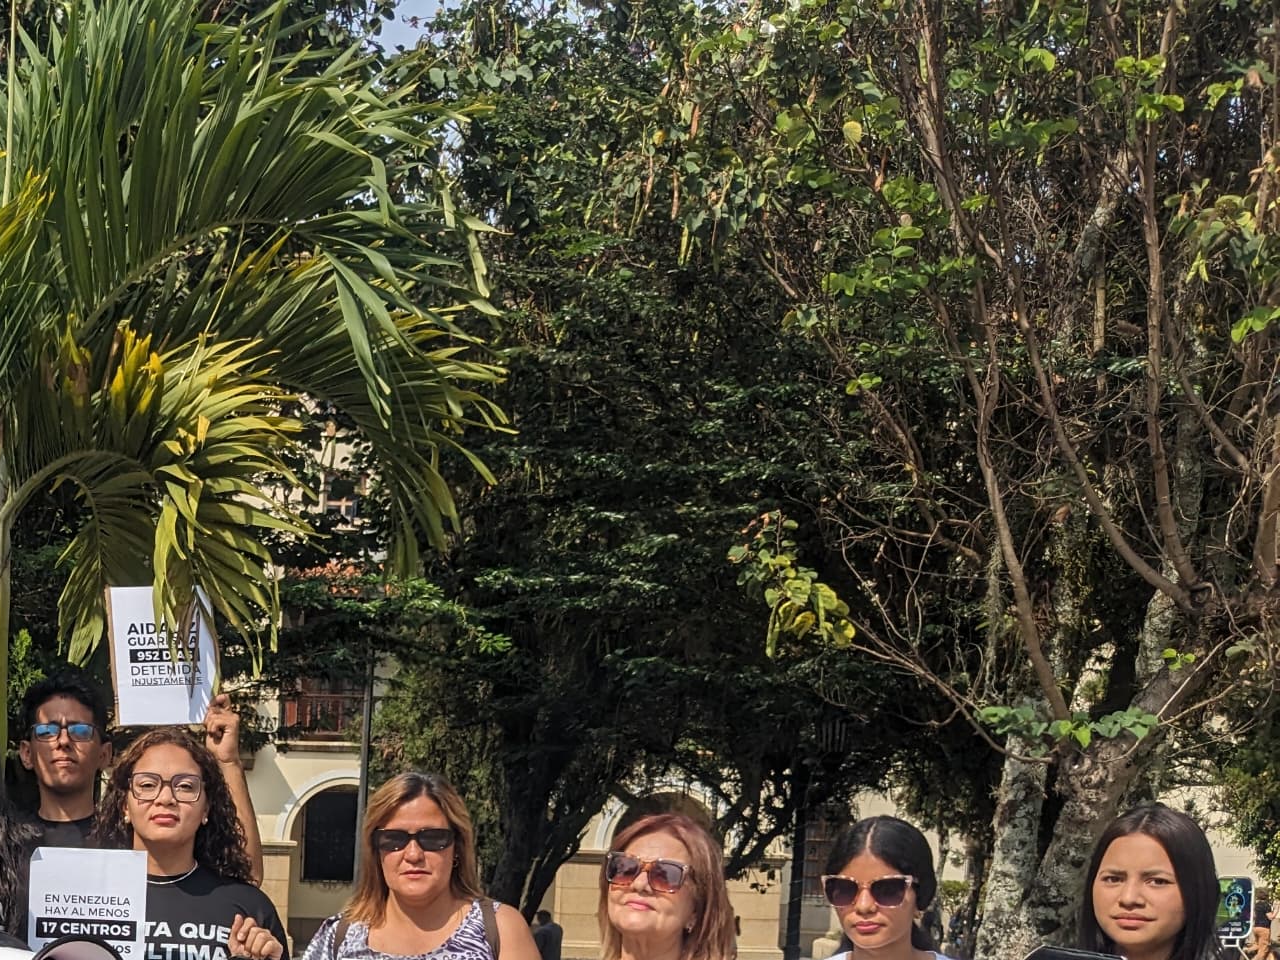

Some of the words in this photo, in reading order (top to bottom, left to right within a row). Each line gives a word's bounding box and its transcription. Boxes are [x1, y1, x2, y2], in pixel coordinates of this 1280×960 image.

[136, 651, 160, 661] 952
[131, 677, 203, 687] INJUSTAMENE
[45, 893, 60, 903] EN
[63, 894, 131, 906] VENEZUELA
[45, 905, 69, 915] HAY
[71, 907, 86, 917] AL
[88, 908, 130, 918] MENOS
[42, 921, 58, 933] 17
[60, 922, 131, 937] CENTROS
[179, 922, 232, 944] QUE
